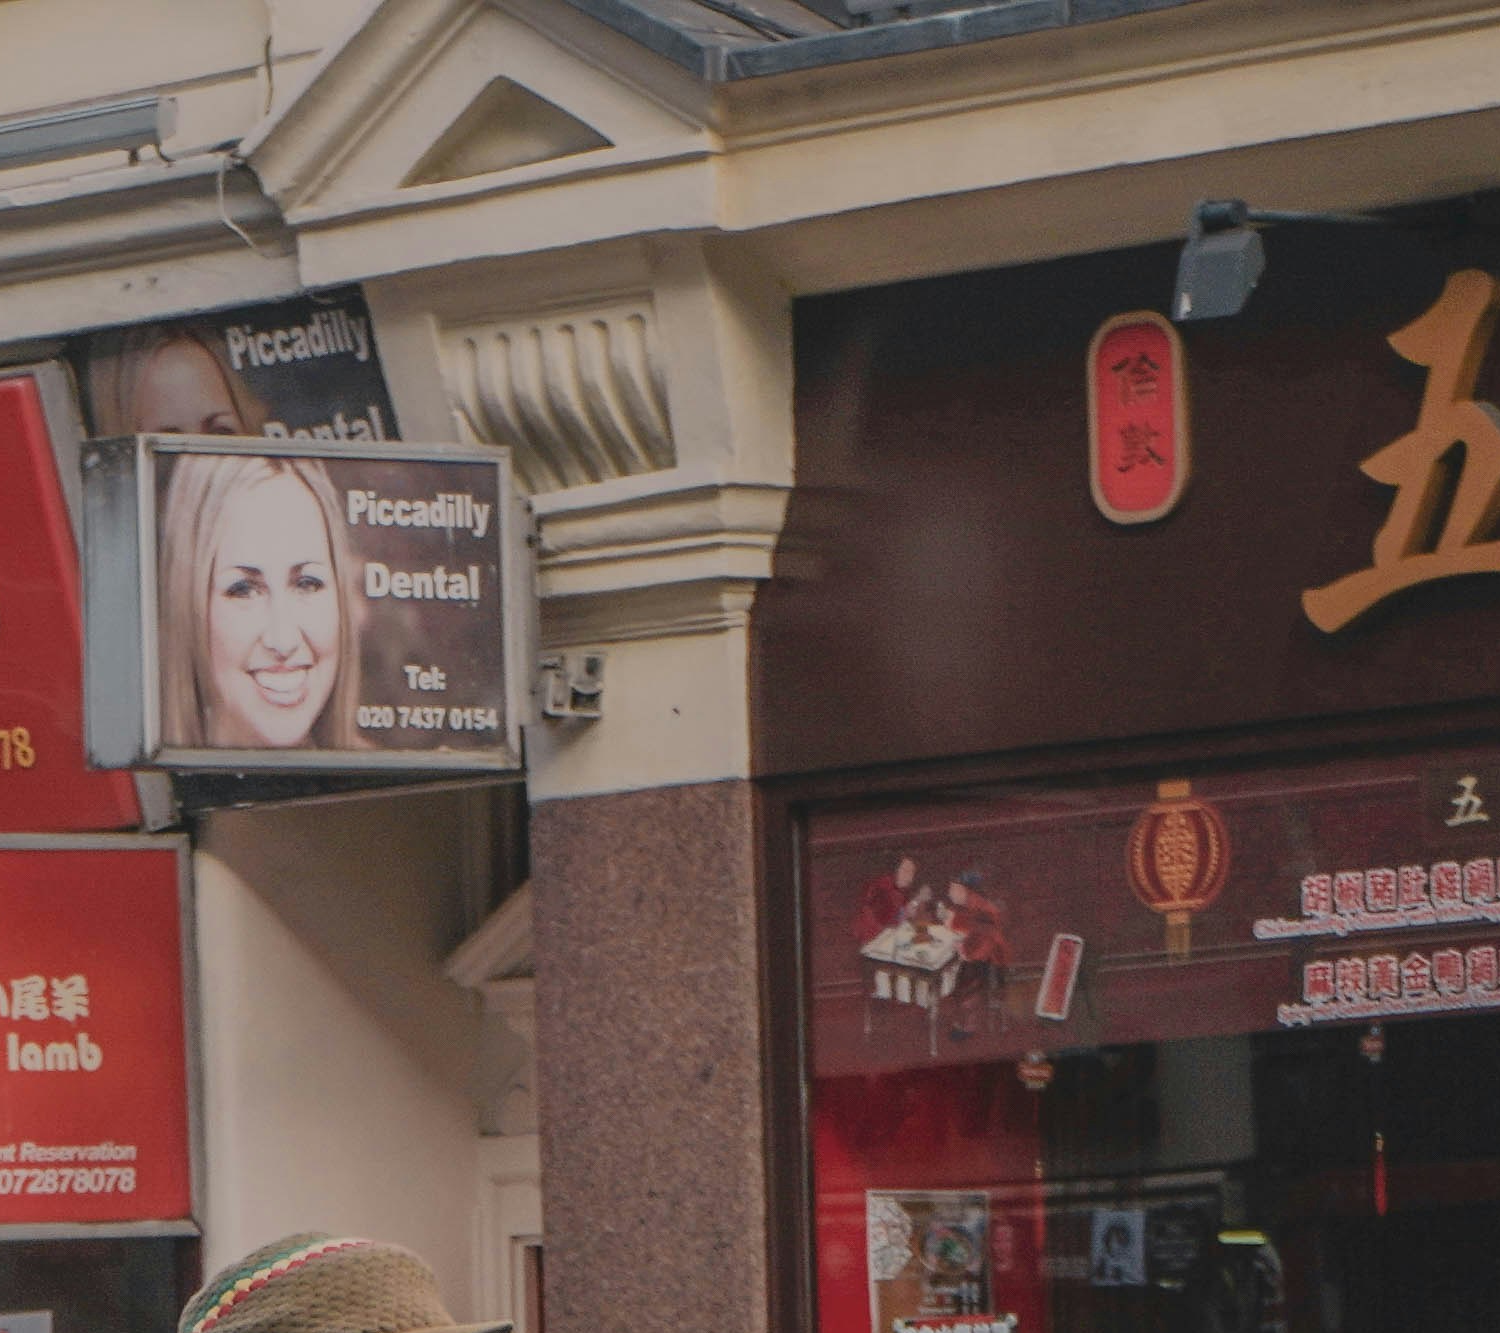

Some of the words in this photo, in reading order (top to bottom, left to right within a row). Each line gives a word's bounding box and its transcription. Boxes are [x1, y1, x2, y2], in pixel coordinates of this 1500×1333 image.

[226, 309, 371, 370] Piccadilly
[347, 490, 490, 537] Piccadilly
[365, 563, 480, 602] Dental
[405, 665, 446, 691] Tel:
[357, 707, 394, 730] 020
[400, 707, 446, 730] 7437
[449, 706, 498, 731] 0154
[7, 1031, 103, 1072] lamb
[20, 1141, 137, 1163] Reservation
